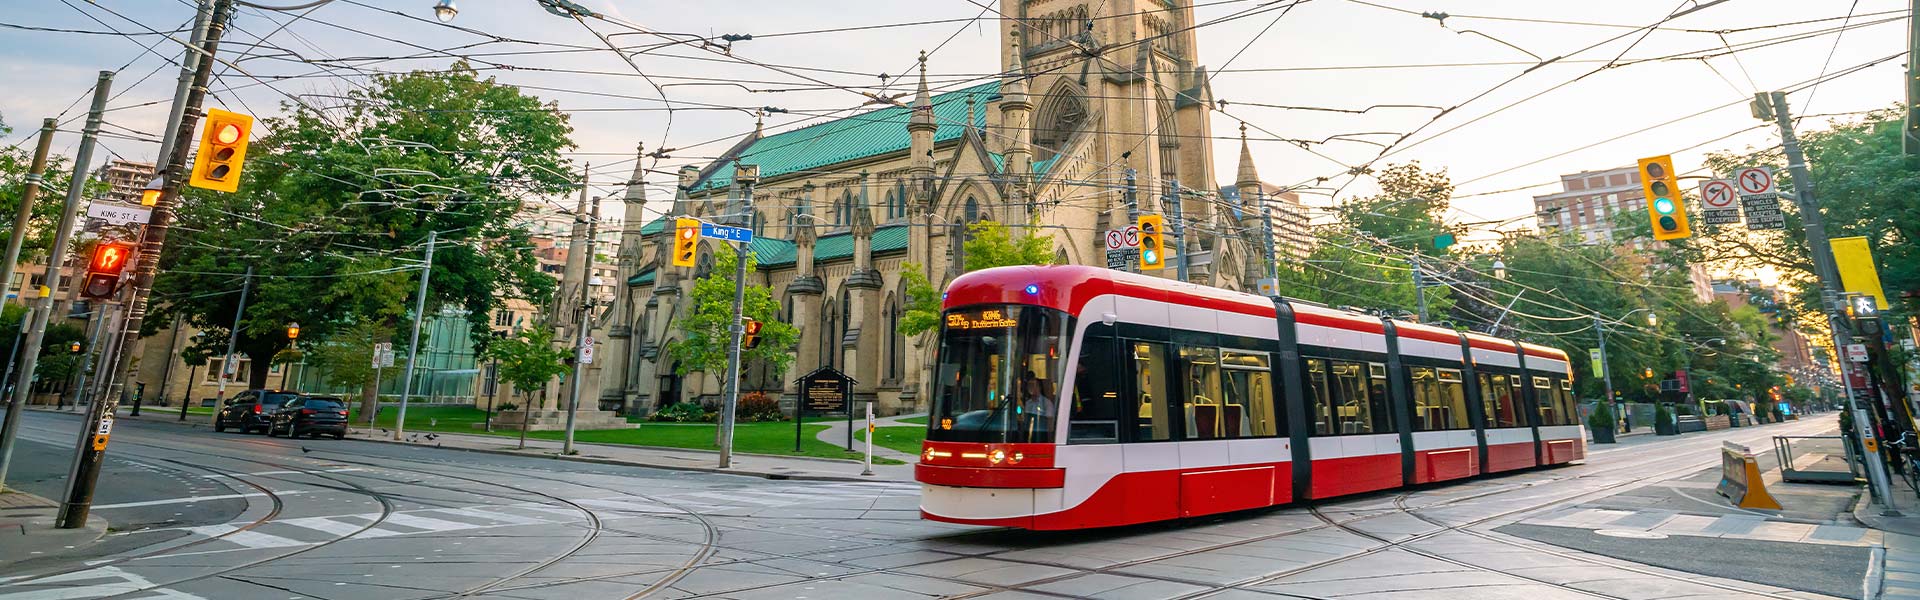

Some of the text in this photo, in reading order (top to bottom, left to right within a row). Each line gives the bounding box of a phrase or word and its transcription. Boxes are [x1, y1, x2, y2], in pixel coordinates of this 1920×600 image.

[101, 210, 117, 218] KING
[713, 227, 729, 239] King
[736, 230, 741, 238] E
